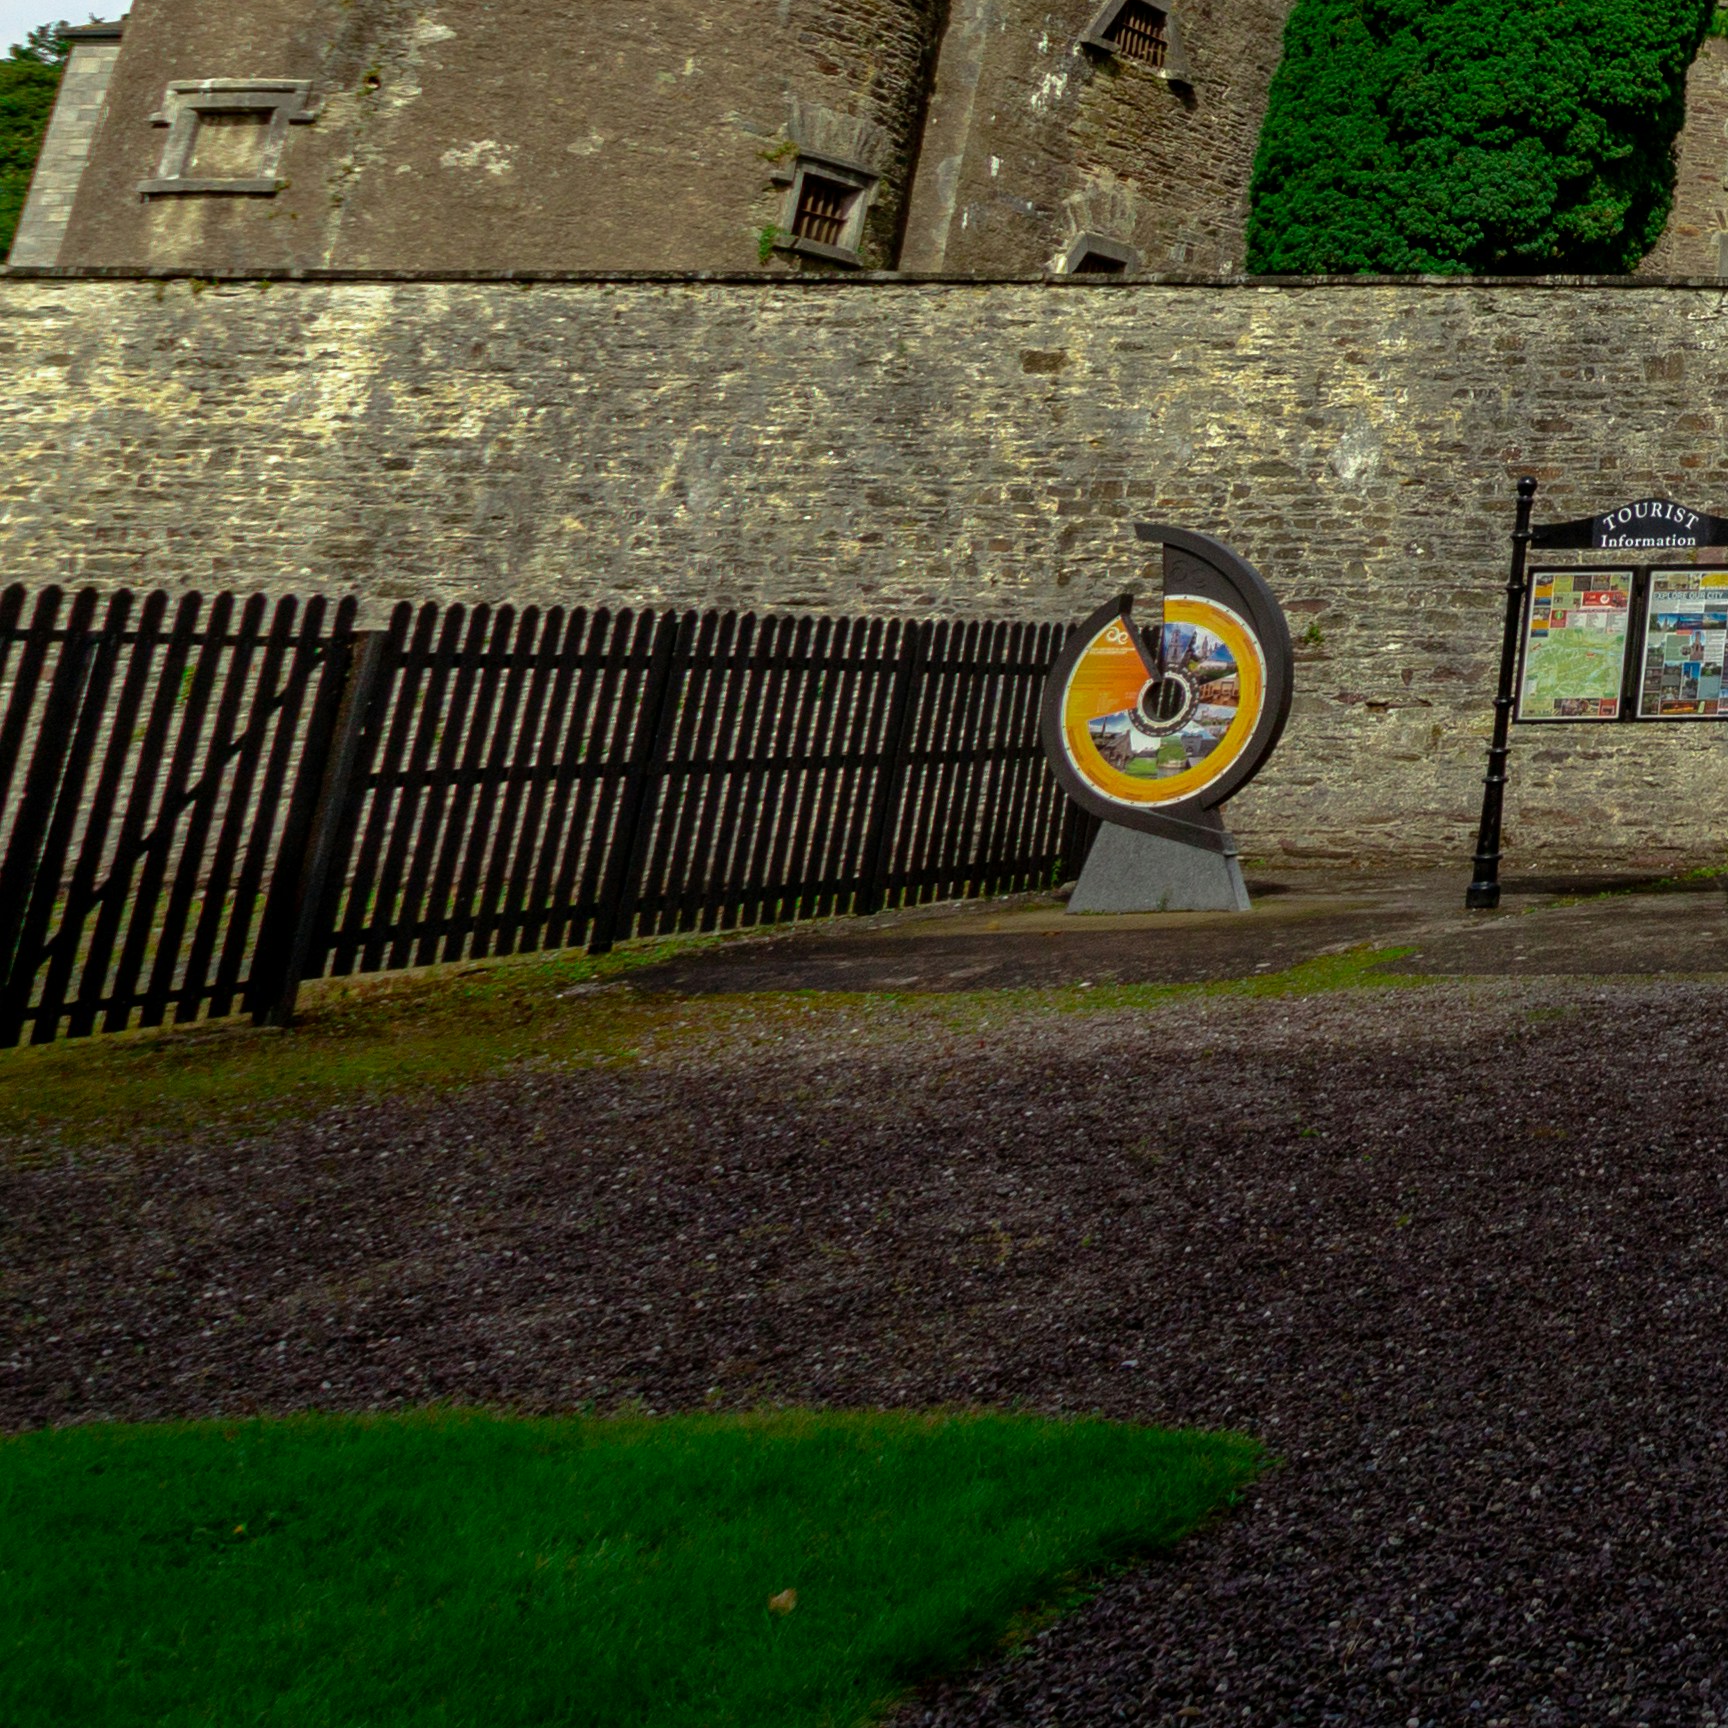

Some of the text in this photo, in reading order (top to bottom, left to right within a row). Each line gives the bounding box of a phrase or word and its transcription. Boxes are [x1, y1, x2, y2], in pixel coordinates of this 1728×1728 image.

[1602, 502, 1699, 531] TOURIST
[1601, 534, 1696, 548] Information
[1653, 591, 1723, 601] EXPLORE OUR CITY
